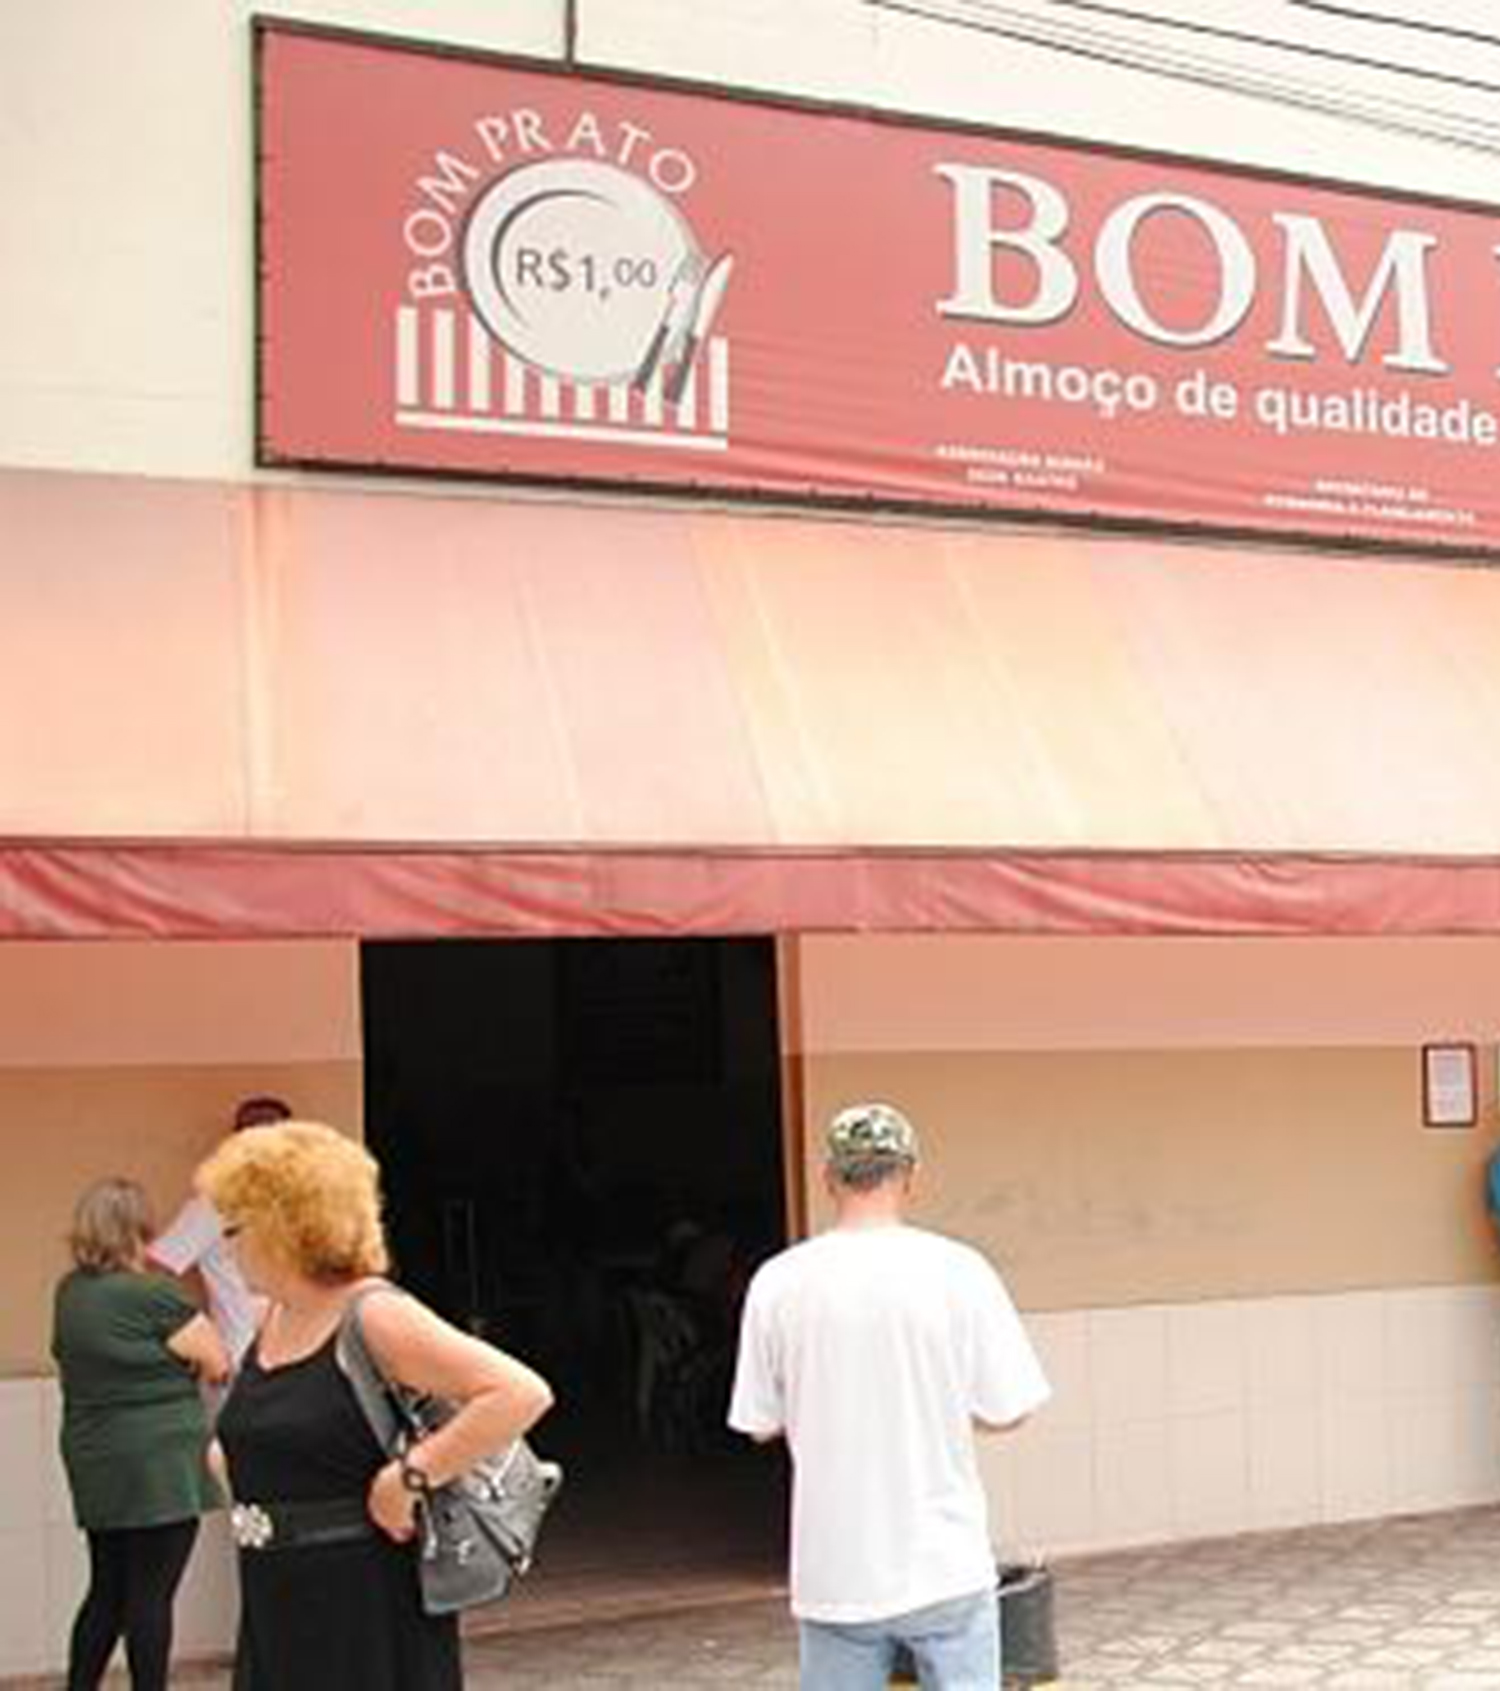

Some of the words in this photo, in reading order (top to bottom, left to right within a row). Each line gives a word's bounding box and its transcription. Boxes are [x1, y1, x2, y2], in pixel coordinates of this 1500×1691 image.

[403, 149, 481, 299] BOM
[475, 107, 696, 193] PRATO
[516, 248, 657, 299] R$1,00
[932, 161, 1451, 375] BOM
[941, 343, 1157, 419] Almoço
[1175, 370, 1239, 419] de
[1255, 386, 1498, 446] qualidade
